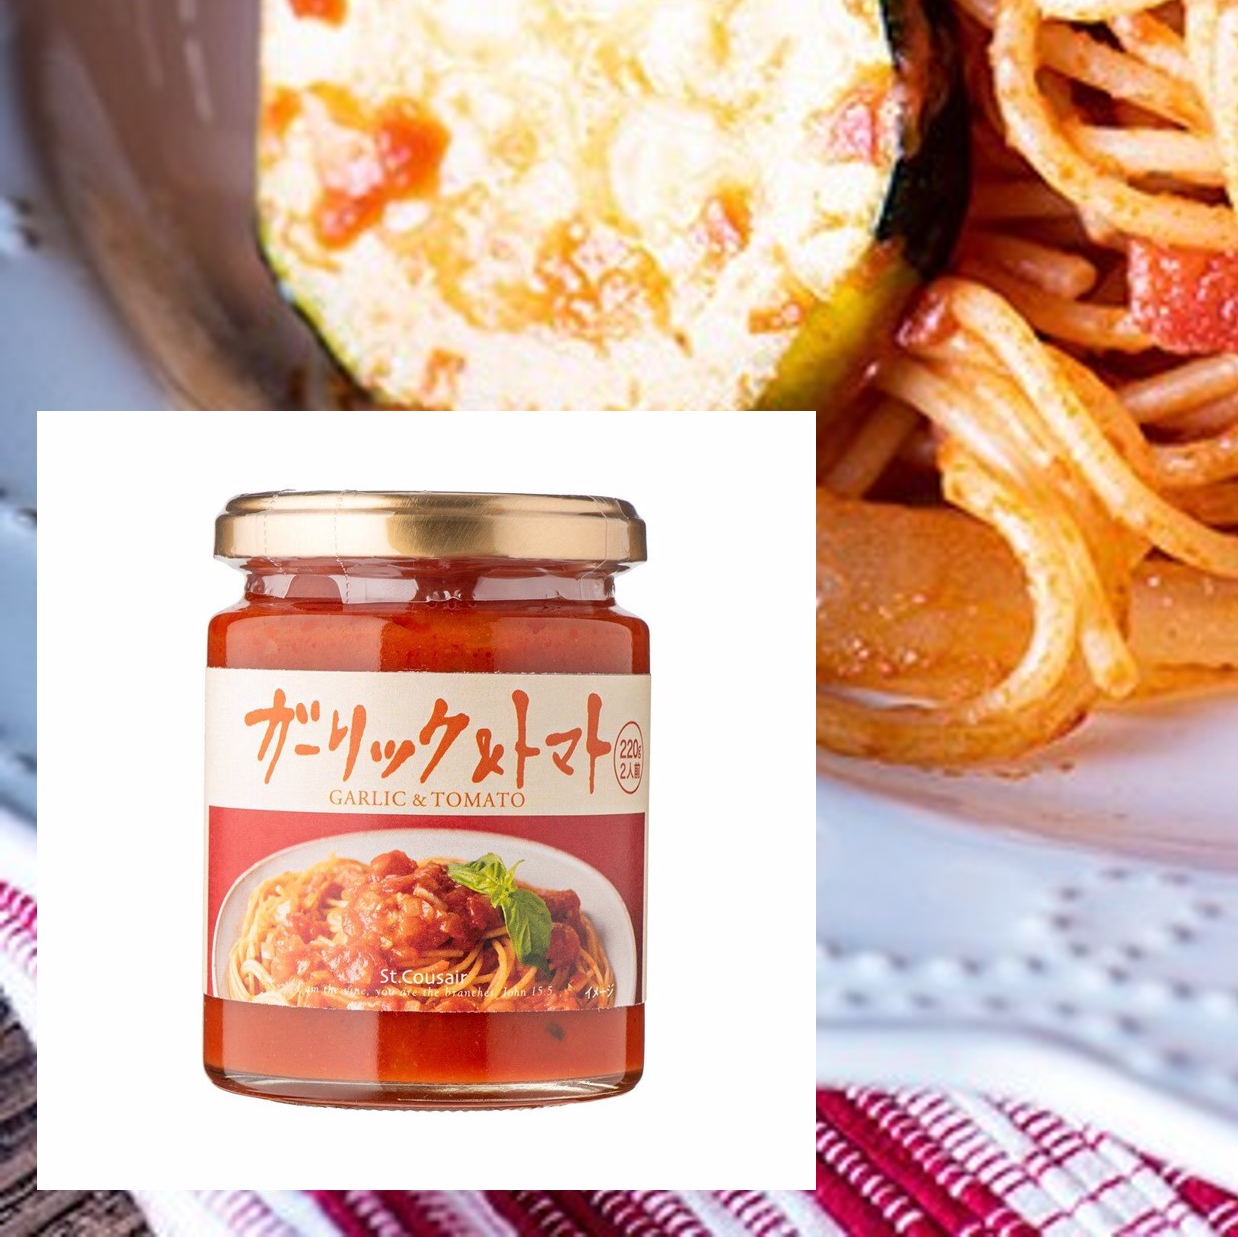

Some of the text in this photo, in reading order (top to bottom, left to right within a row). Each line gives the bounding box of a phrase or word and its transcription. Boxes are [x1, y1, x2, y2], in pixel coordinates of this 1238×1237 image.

[620, 739, 642, 759] 220g
[329, 789, 526, 808] GARLIC & TOMATO
[380, 969, 468, 985] St.Cousair
[422, 987, 440, 997] the
[584, 983, 615, 999] イメージ
